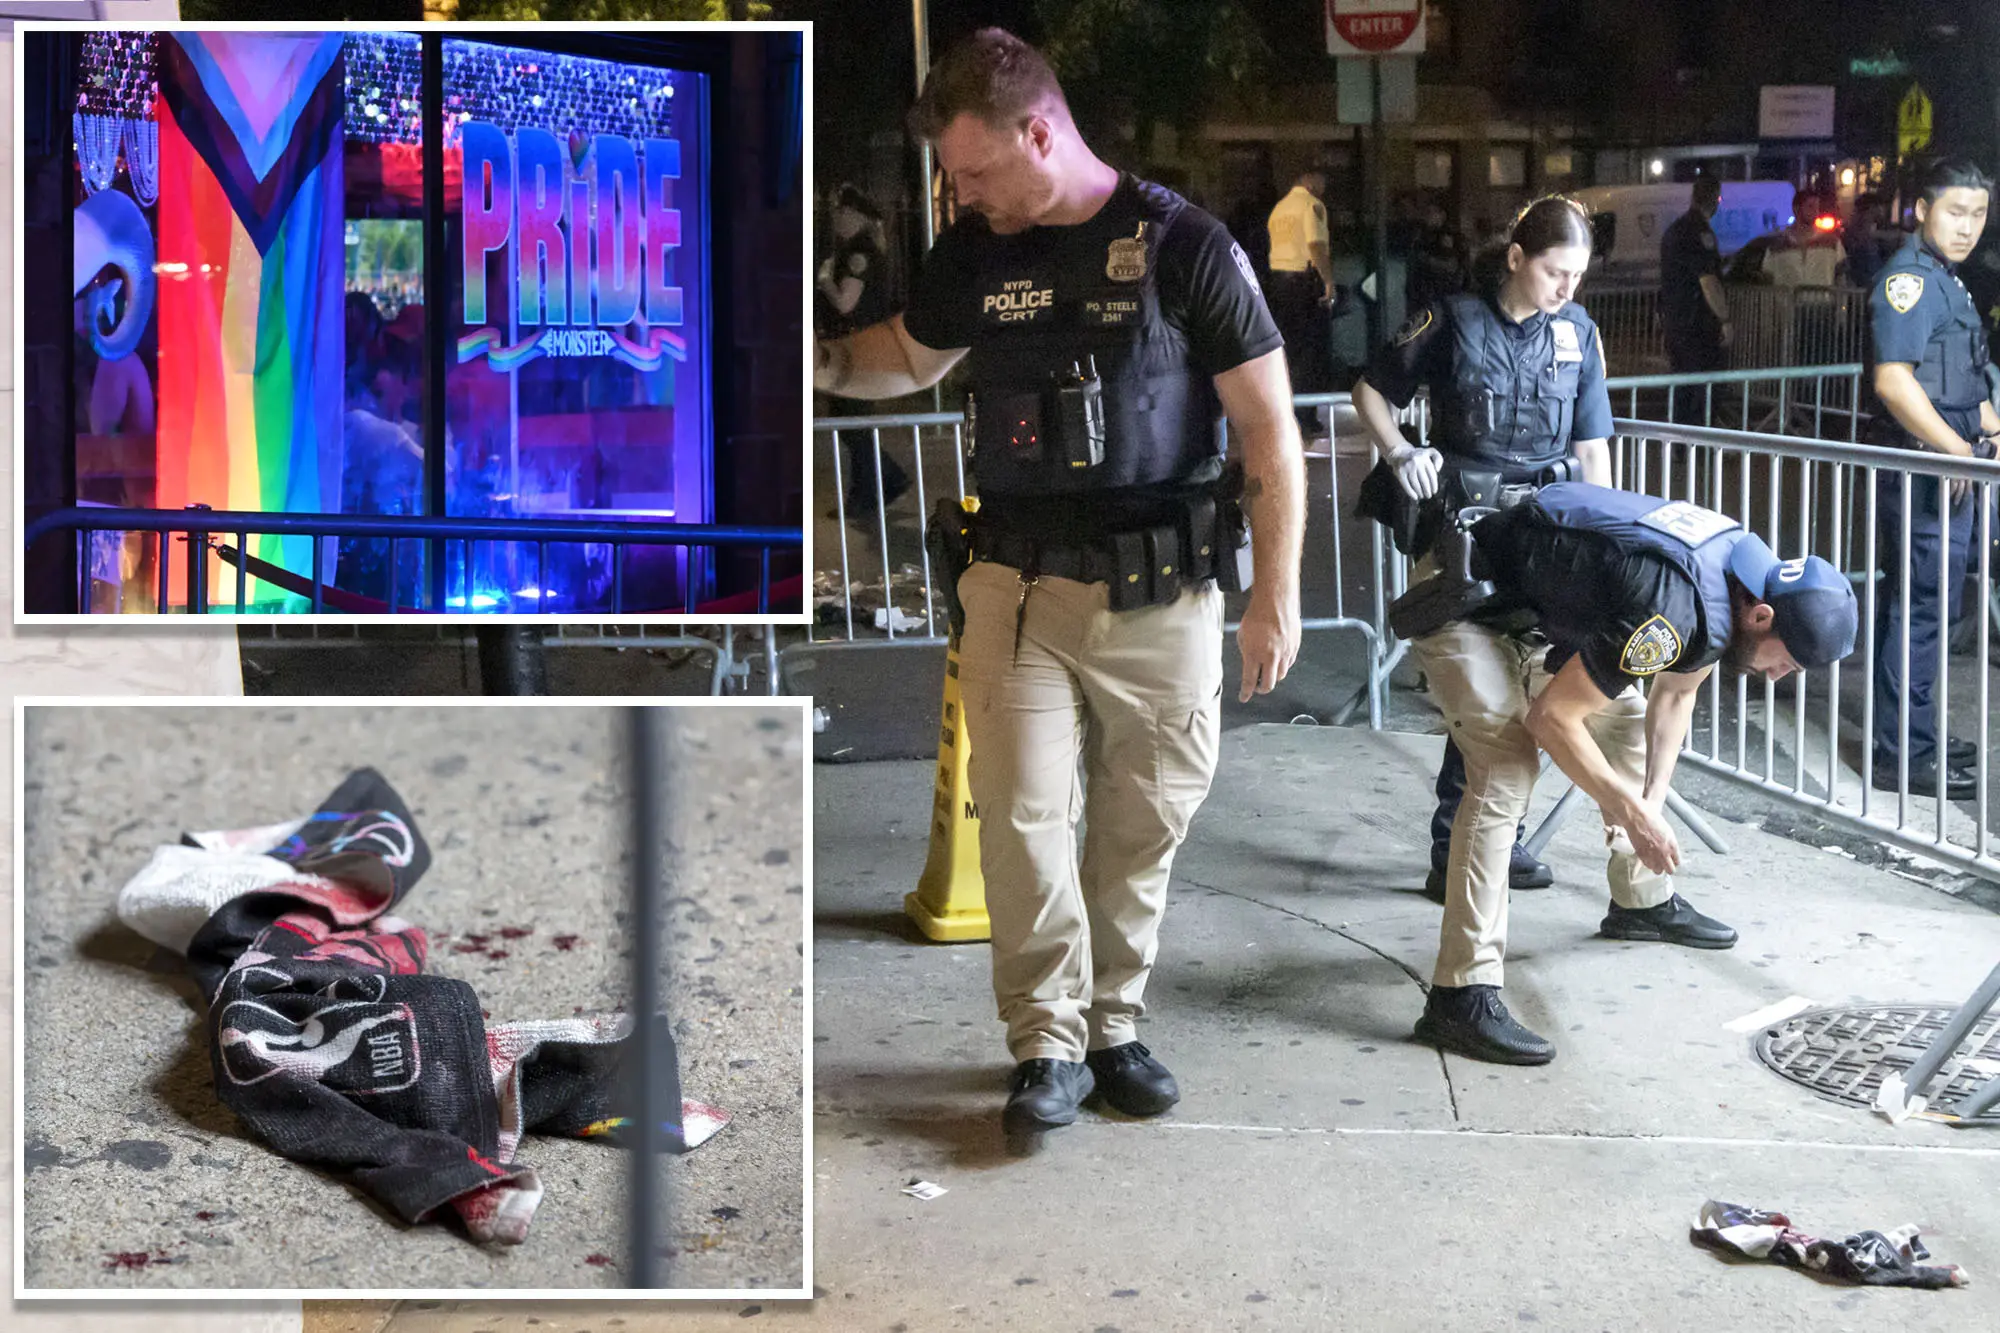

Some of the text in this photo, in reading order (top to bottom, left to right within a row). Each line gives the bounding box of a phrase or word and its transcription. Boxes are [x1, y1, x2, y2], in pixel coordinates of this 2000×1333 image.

[1350, 17, 1404, 35] ENTER
[1003, 280, 1033, 291] NYPD
[983, 289, 1053, 313] POLICE
[1106, 302, 1137, 311] STEELE
[999, 310, 1038, 321] CRT
[553, 330, 609, 357] MONSTER
[367, 1031, 405, 1078] NBA
